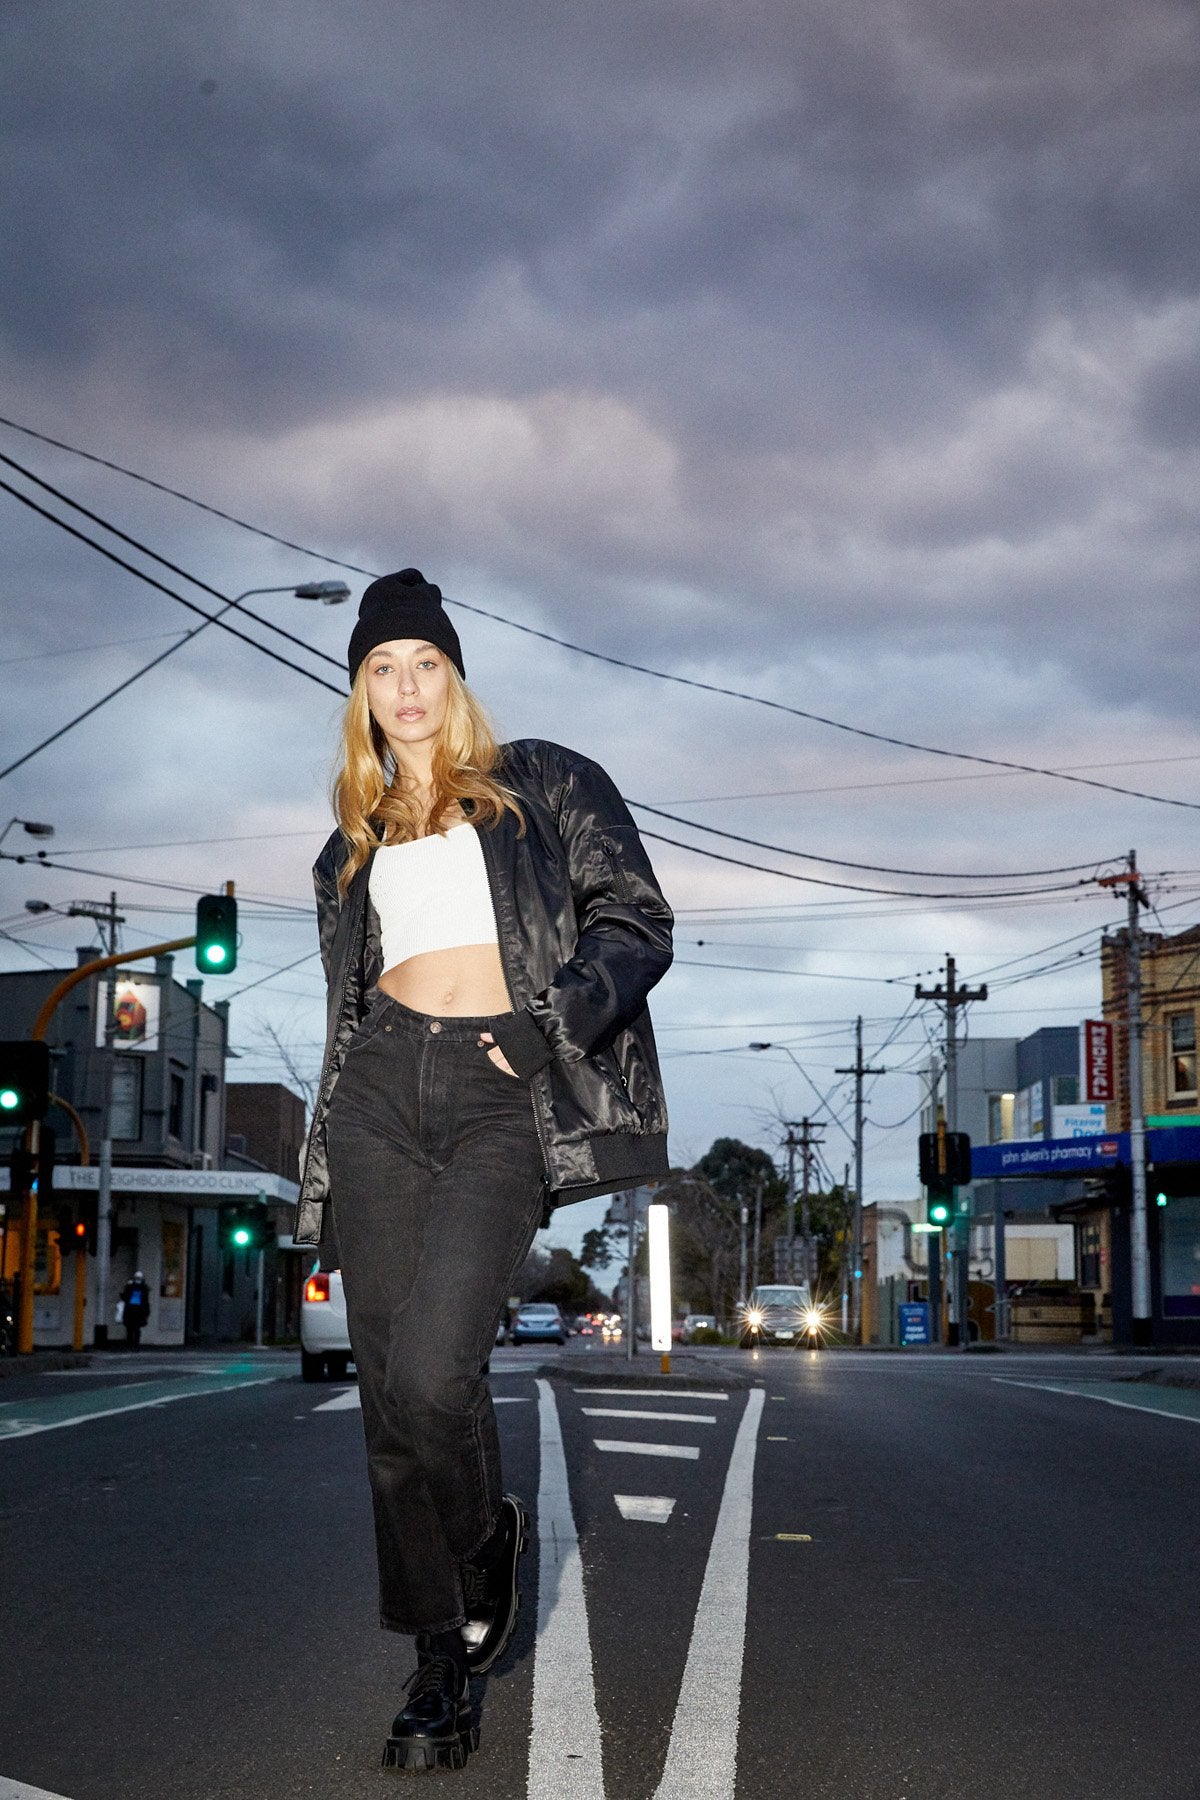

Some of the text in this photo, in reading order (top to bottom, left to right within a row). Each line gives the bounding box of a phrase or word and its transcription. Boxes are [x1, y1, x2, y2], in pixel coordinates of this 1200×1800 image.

[1092, 1025, 1108, 1096] MEDICAL
[1051, 1145, 1093, 1162] pharmacy
[69, 1171, 95, 1185] THE
[109, 1172, 217, 1187] EIGHBOURHOOD
